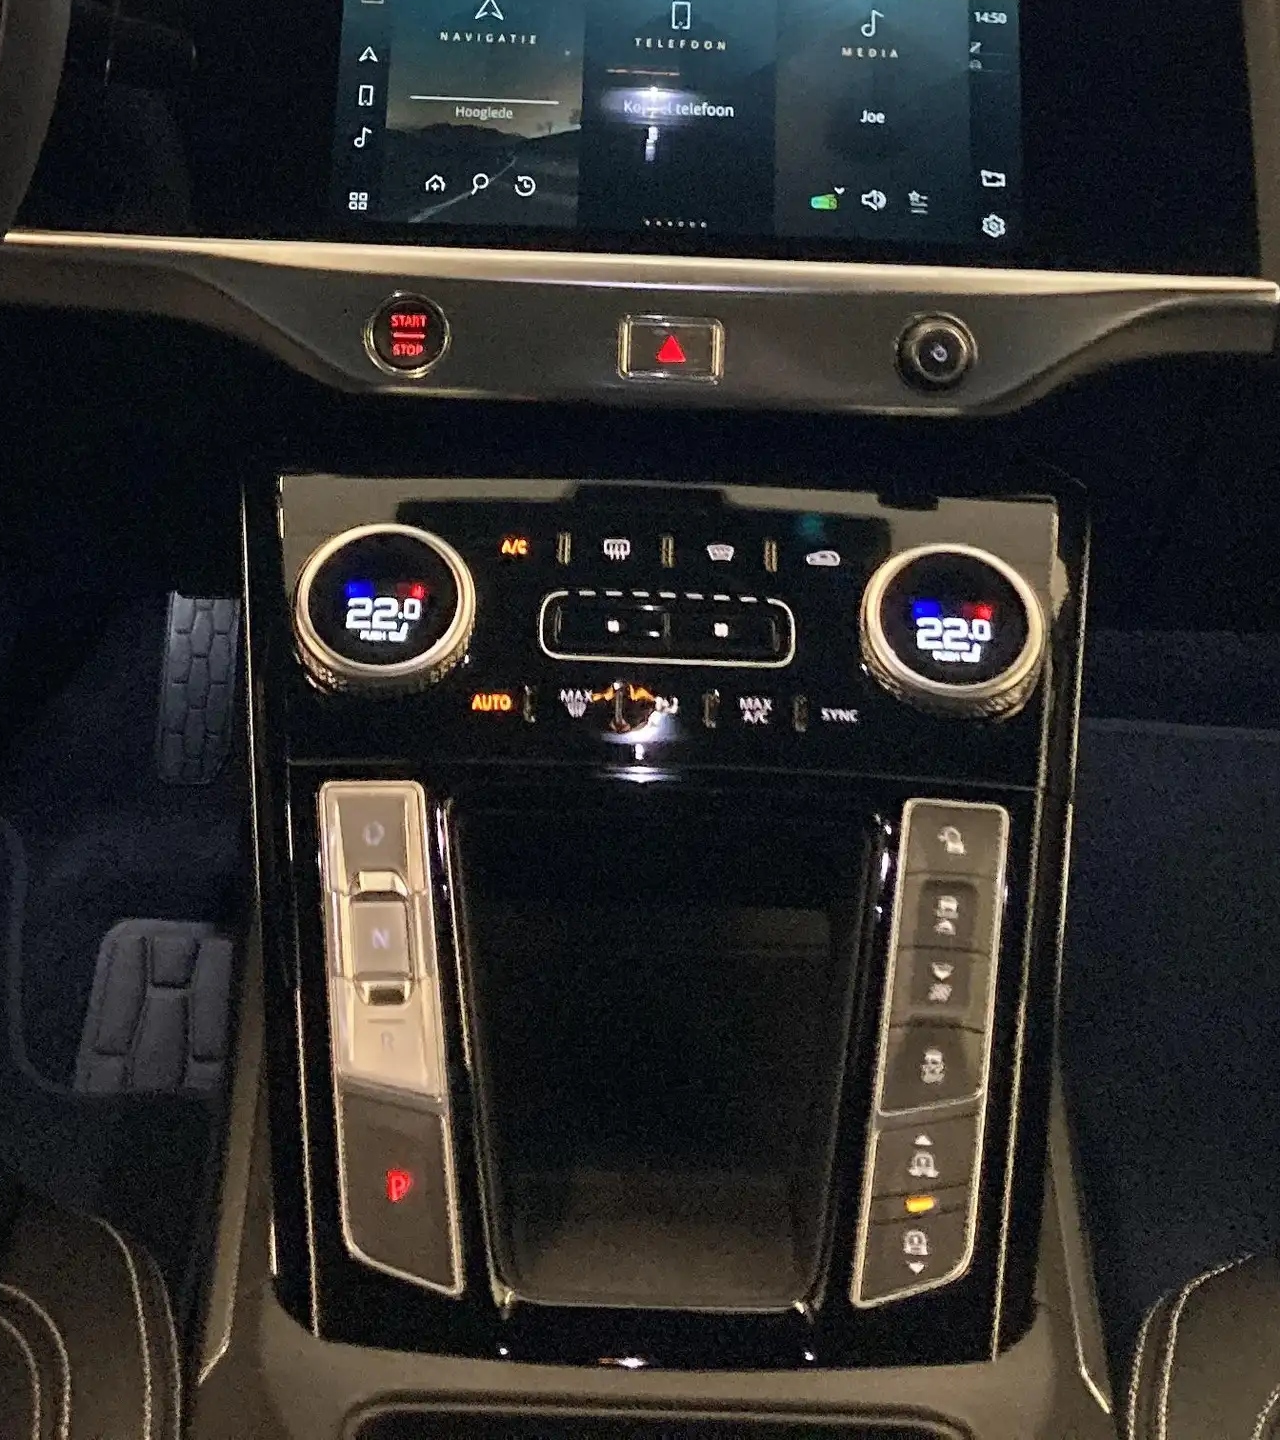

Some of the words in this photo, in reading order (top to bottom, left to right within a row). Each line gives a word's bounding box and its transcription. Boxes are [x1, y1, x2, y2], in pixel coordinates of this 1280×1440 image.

[440, 31, 537, 45] NAVIGATIE
[635, 37, 726, 50] TELEFOON
[841, 47, 899, 58] MEDIA
[455, 105, 513, 120] Hooglede
[676, 102, 734, 117] telefoon
[860, 110, 886, 124] Joe
[391, 314, 426, 328] START
[392, 343, 424, 356] STOP
[501, 538, 527, 555] A/C
[345, 597, 421, 630] 22.0
[916, 616, 991, 650] 22.0
[472, 693, 512, 711] AUTO
[560, 687, 593, 703] MAX
[739, 697, 772, 710] MAX
[743, 709, 768, 725] A/C
[821, 707, 859, 723] SYNC
[370, 927, 390, 950] N
[389, 1171, 410, 1200] P
